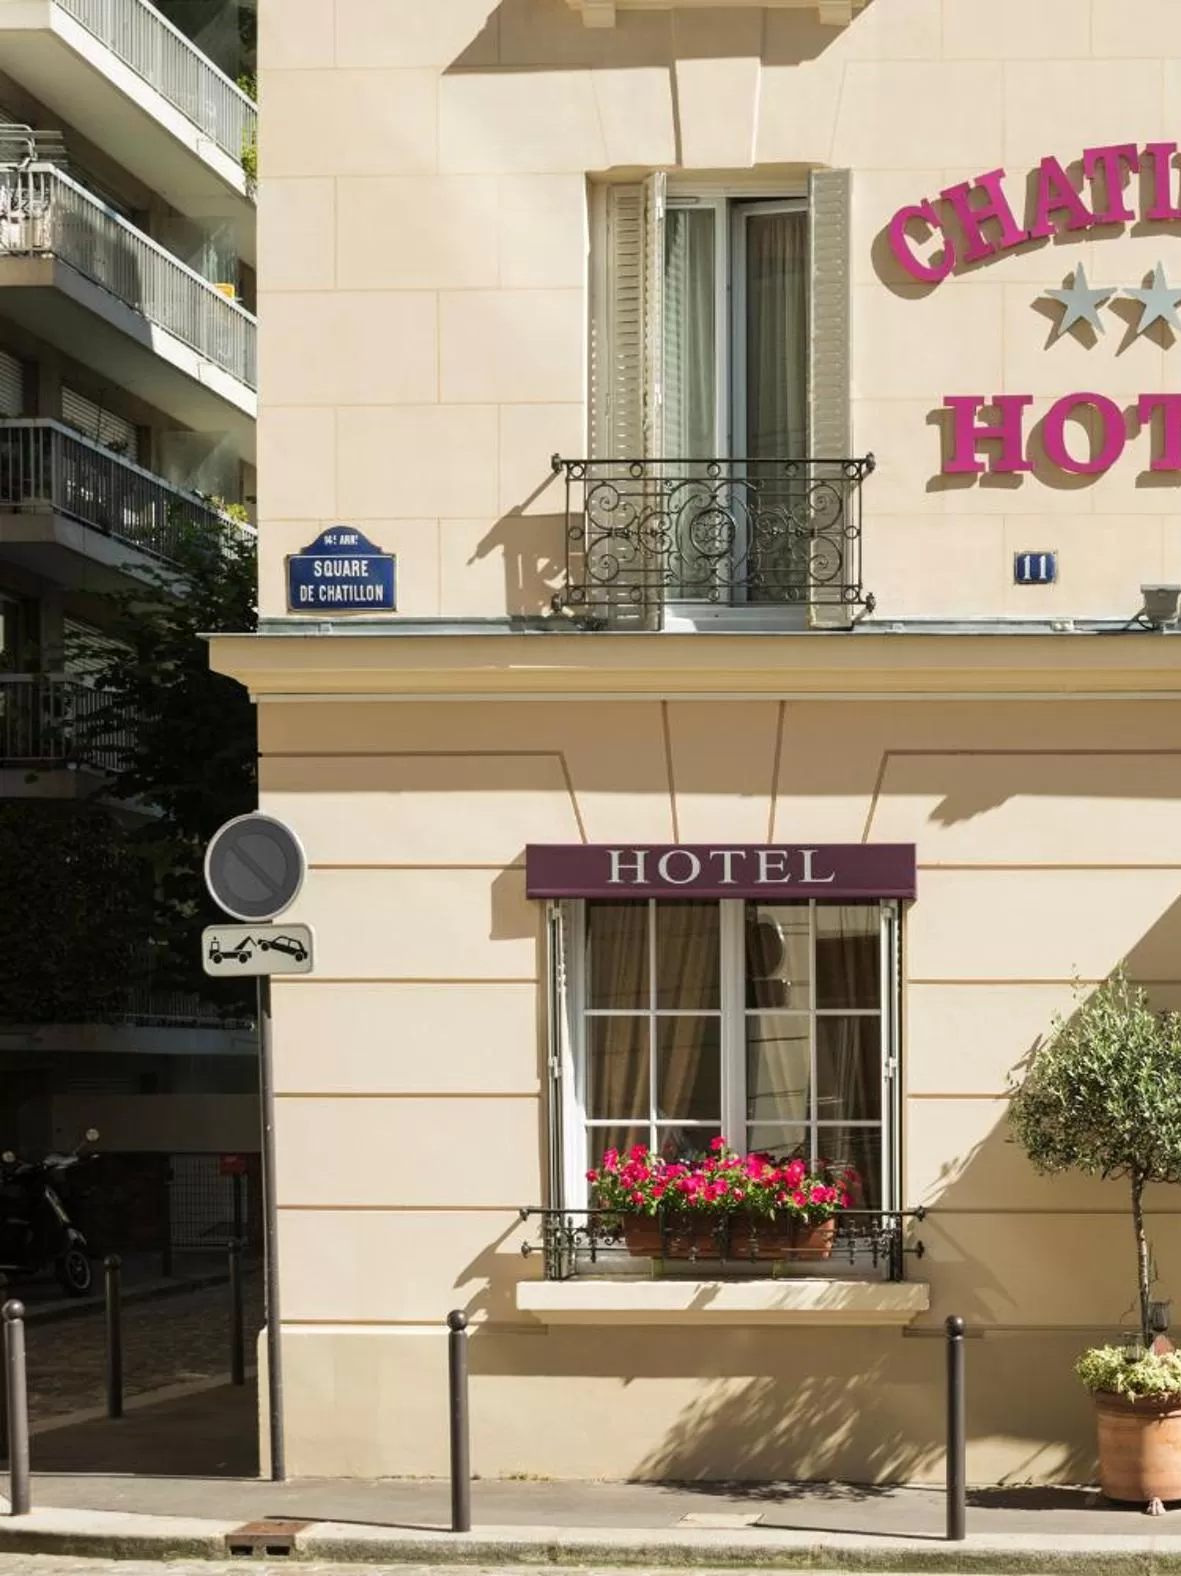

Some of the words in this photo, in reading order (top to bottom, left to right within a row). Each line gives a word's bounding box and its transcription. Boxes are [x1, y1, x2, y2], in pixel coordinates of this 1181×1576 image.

[314, 560, 369, 577] SQUARE
[1023, 555, 1047, 580] 11
[300, 584, 315, 602] DE
[319, 584, 384, 602] CHATILLON
[605, 849, 836, 885] HOTEL
